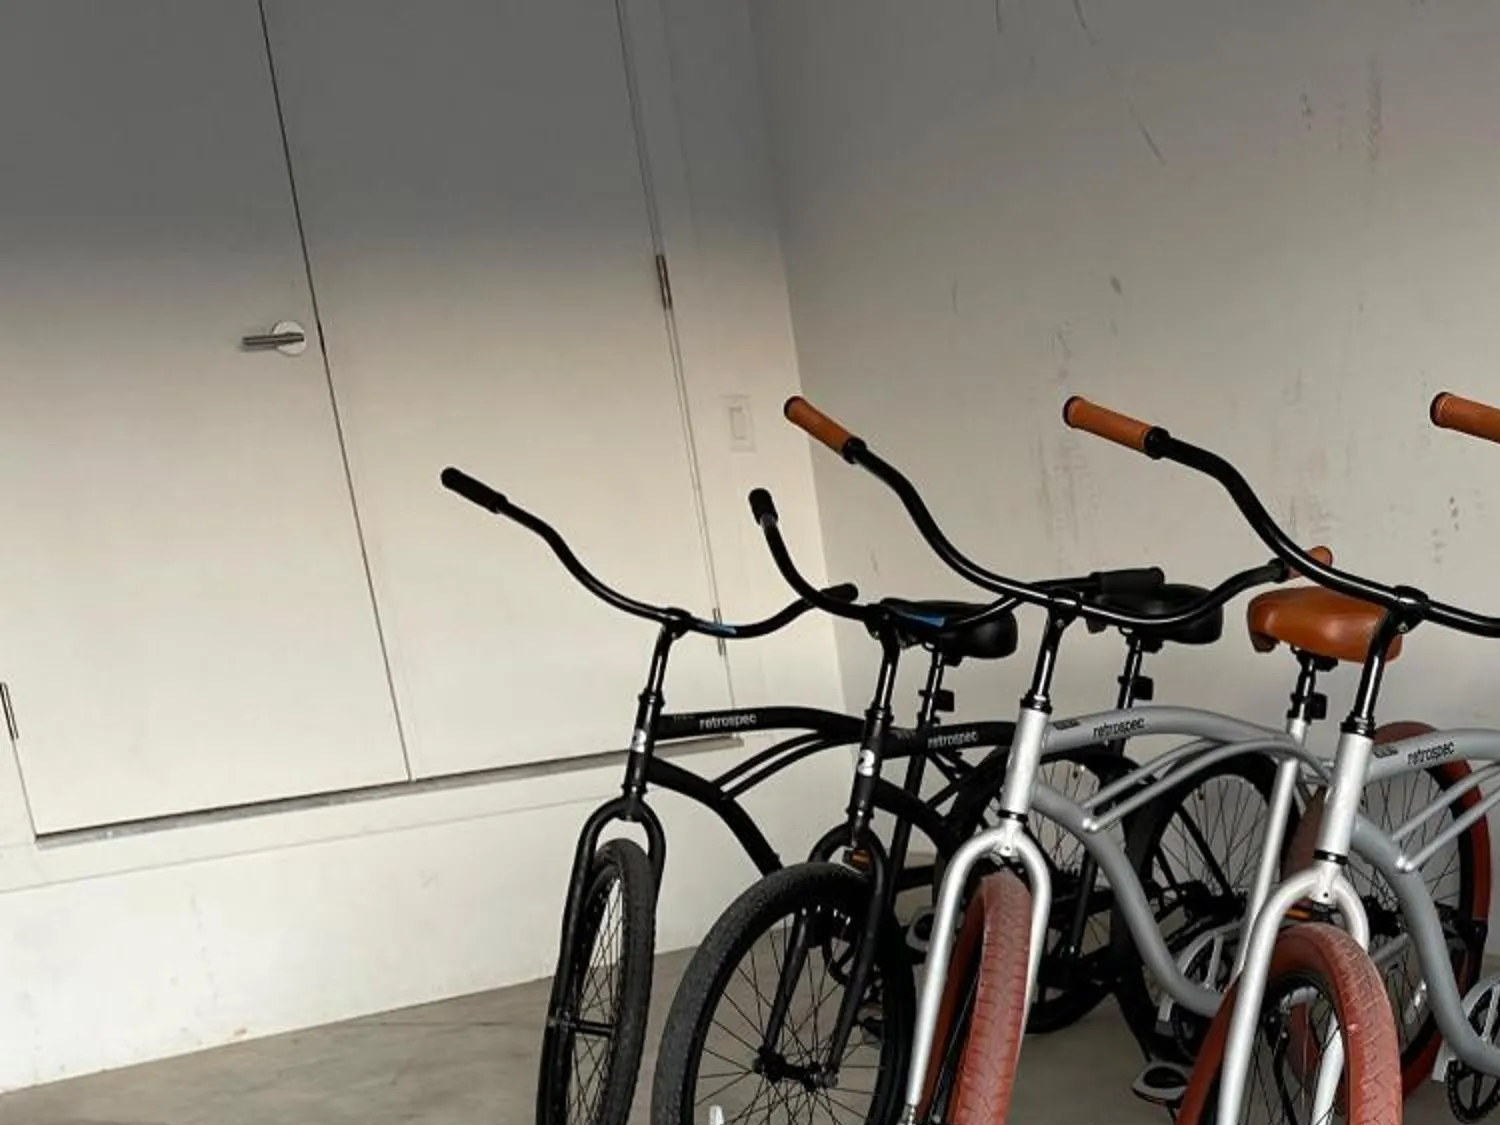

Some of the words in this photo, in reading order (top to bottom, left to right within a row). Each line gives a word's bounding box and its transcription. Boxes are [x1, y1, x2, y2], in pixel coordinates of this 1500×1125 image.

[699, 713, 756, 729] retrospec
[1092, 717, 1145, 738] retrospec
[1407, 741, 1455, 765] retrospec
